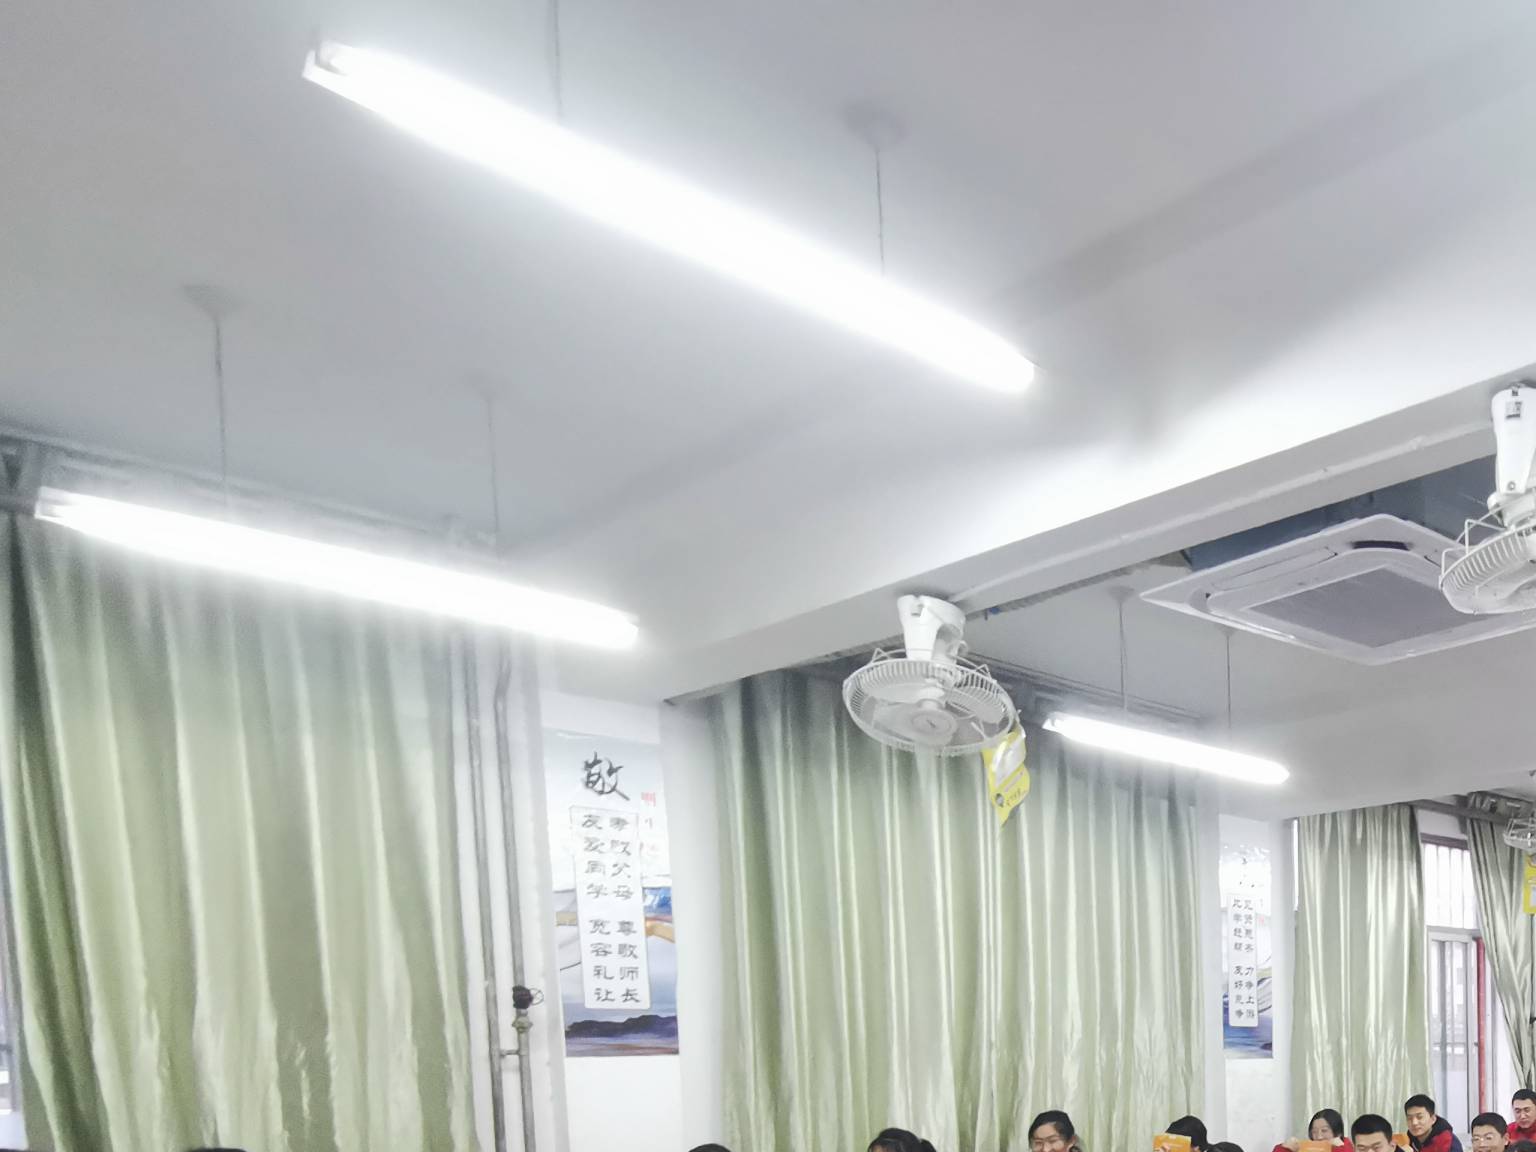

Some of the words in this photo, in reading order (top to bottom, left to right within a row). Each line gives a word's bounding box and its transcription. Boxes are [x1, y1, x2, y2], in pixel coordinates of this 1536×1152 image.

[582, 751, 630, 801] 敬
[588, 919, 615, 1003] 宽容礼让
[617, 919, 641, 1003] 尊敬师长
